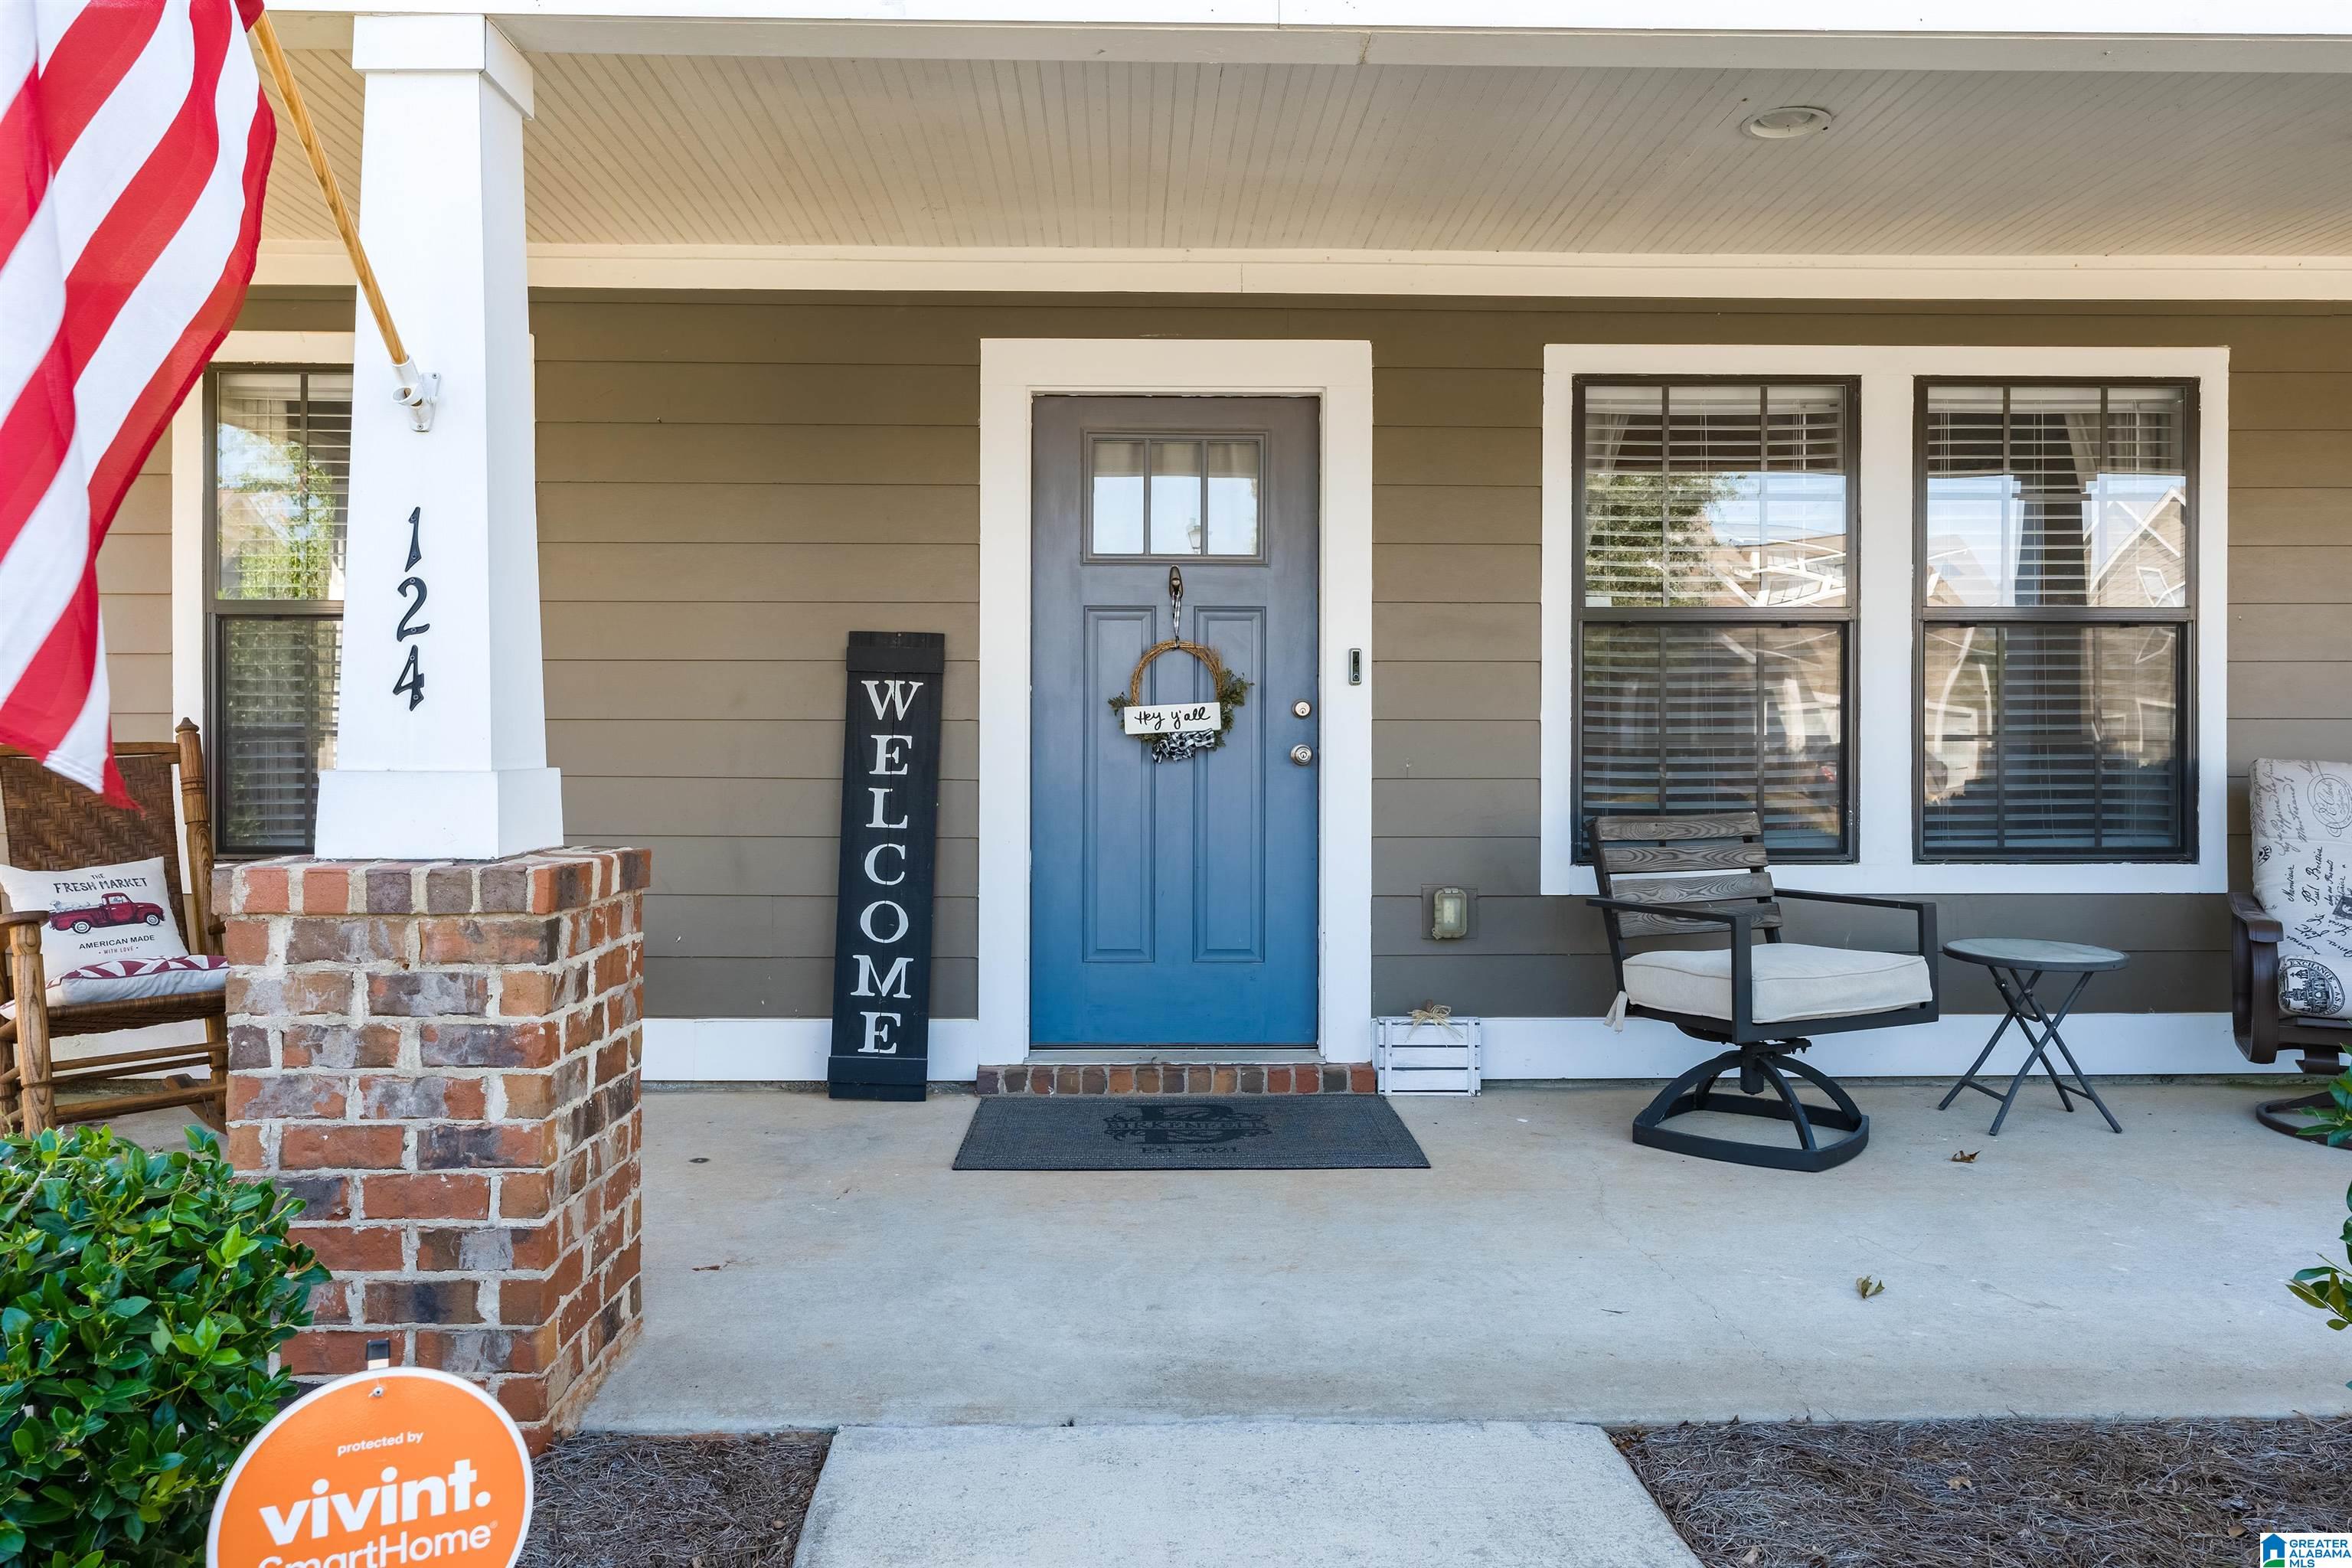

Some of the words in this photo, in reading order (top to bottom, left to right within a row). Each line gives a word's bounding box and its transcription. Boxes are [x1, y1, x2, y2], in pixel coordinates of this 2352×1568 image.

[393, 506, 430, 712] 124
[1134, 711, 1165, 730] Hey
[1171, 707, 1210, 730] y'all
[850, 679, 924, 1054] WELCOME
[53, 881, 97, 893] FRESH
[100, 877, 148, 890] MARKET
[79, 938, 129, 949] AMERICAN
[338, 1432, 403, 1457] protected
[407, 1430, 424, 1444] by
